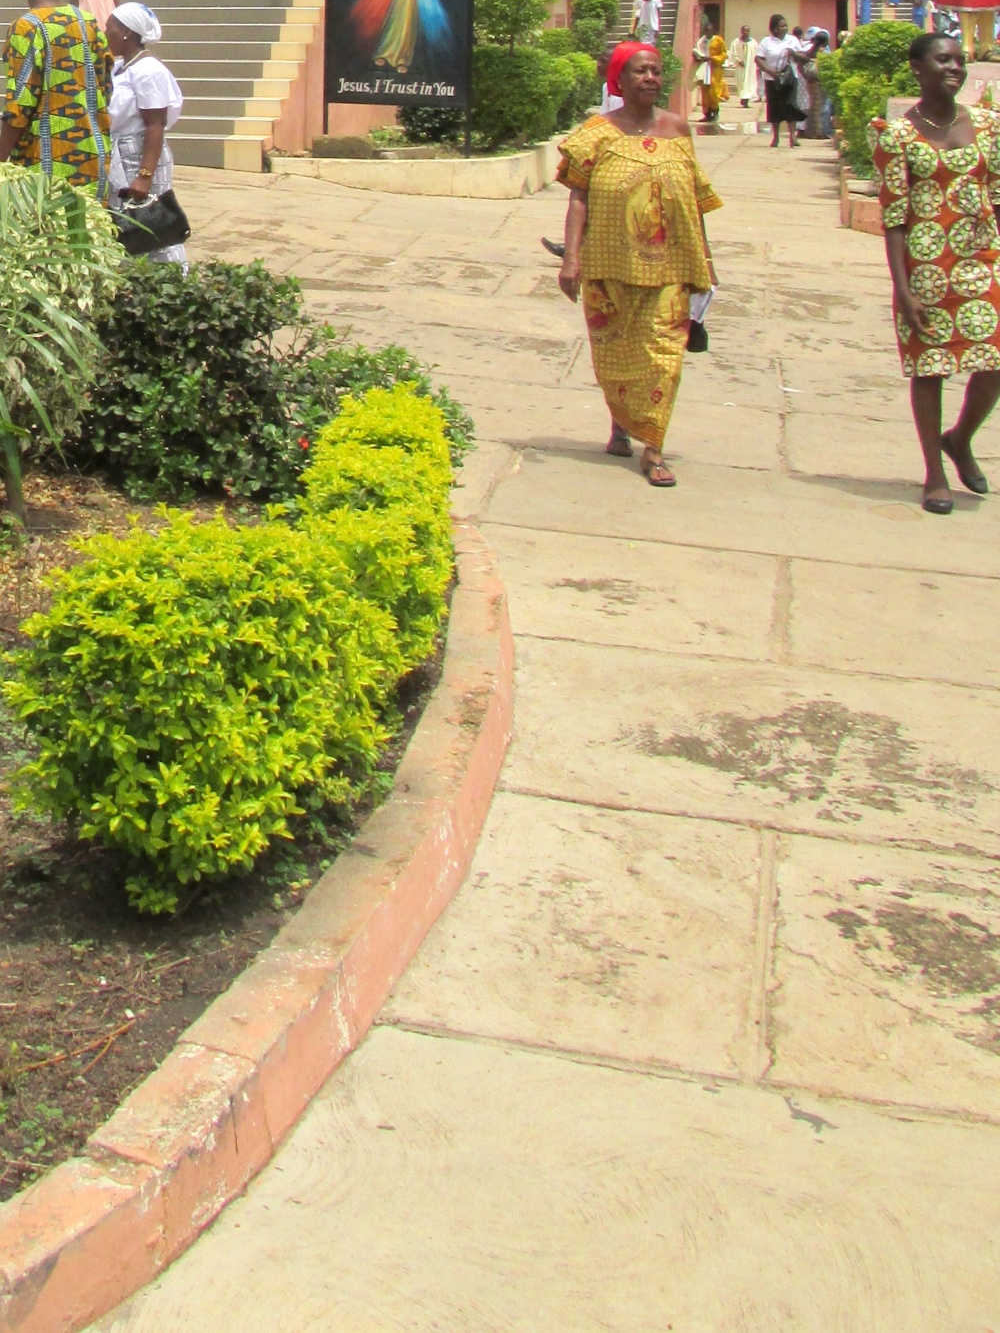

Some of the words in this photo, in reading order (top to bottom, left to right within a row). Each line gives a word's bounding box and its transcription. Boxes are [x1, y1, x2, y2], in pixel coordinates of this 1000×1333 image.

[374, 79, 380, 93] I
[383, 79, 419, 94] Trust
[420, 82, 432, 95] in
[433, 82, 455, 96] You
